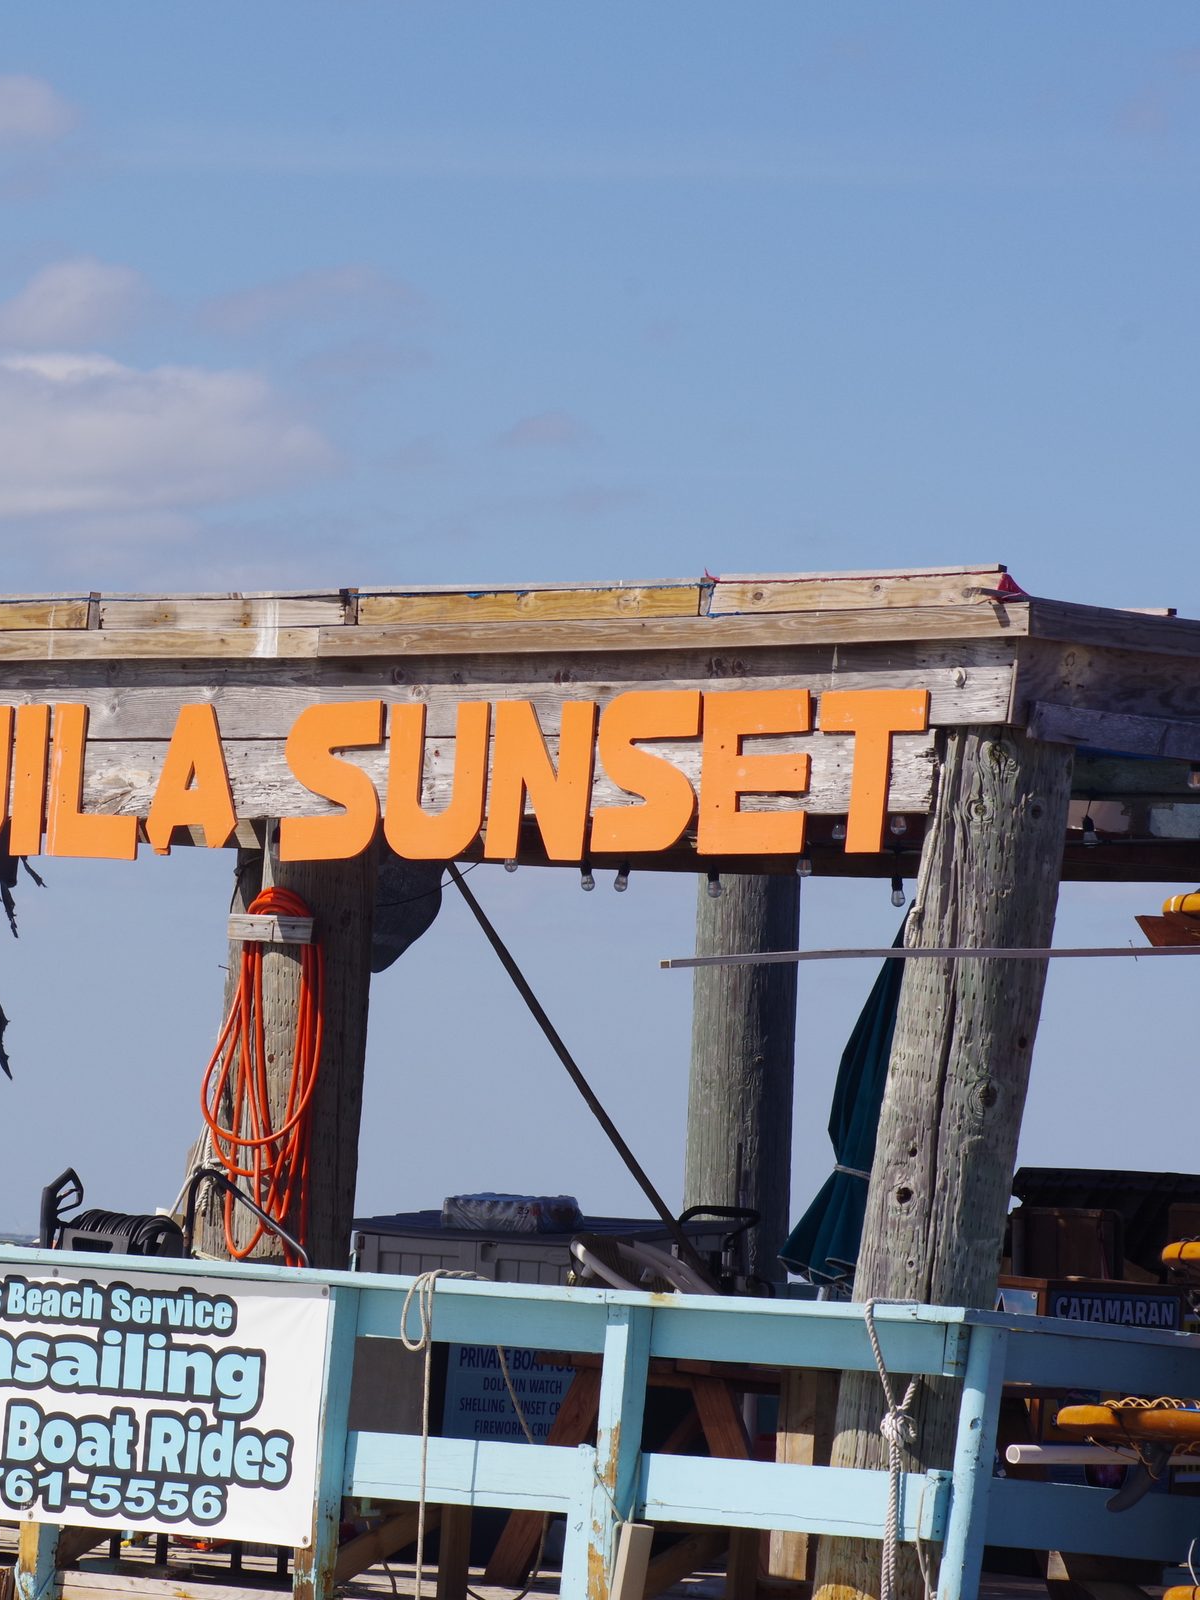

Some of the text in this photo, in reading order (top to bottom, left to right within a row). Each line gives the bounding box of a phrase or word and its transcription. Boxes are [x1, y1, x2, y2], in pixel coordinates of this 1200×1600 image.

[279, 689, 930, 862] SUNSET
[5, 1281, 103, 1321] Beach
[109, 1287, 233, 1330] Service
[1055, 1296, 1175, 1326] CATAMARAN
[459, 1397, 505, 1414] SHELLING
[529, 1379, 563, 1395] WATCH
[6, 1404, 135, 1472] Boat
[147, 1413, 290, 1483] Rides
